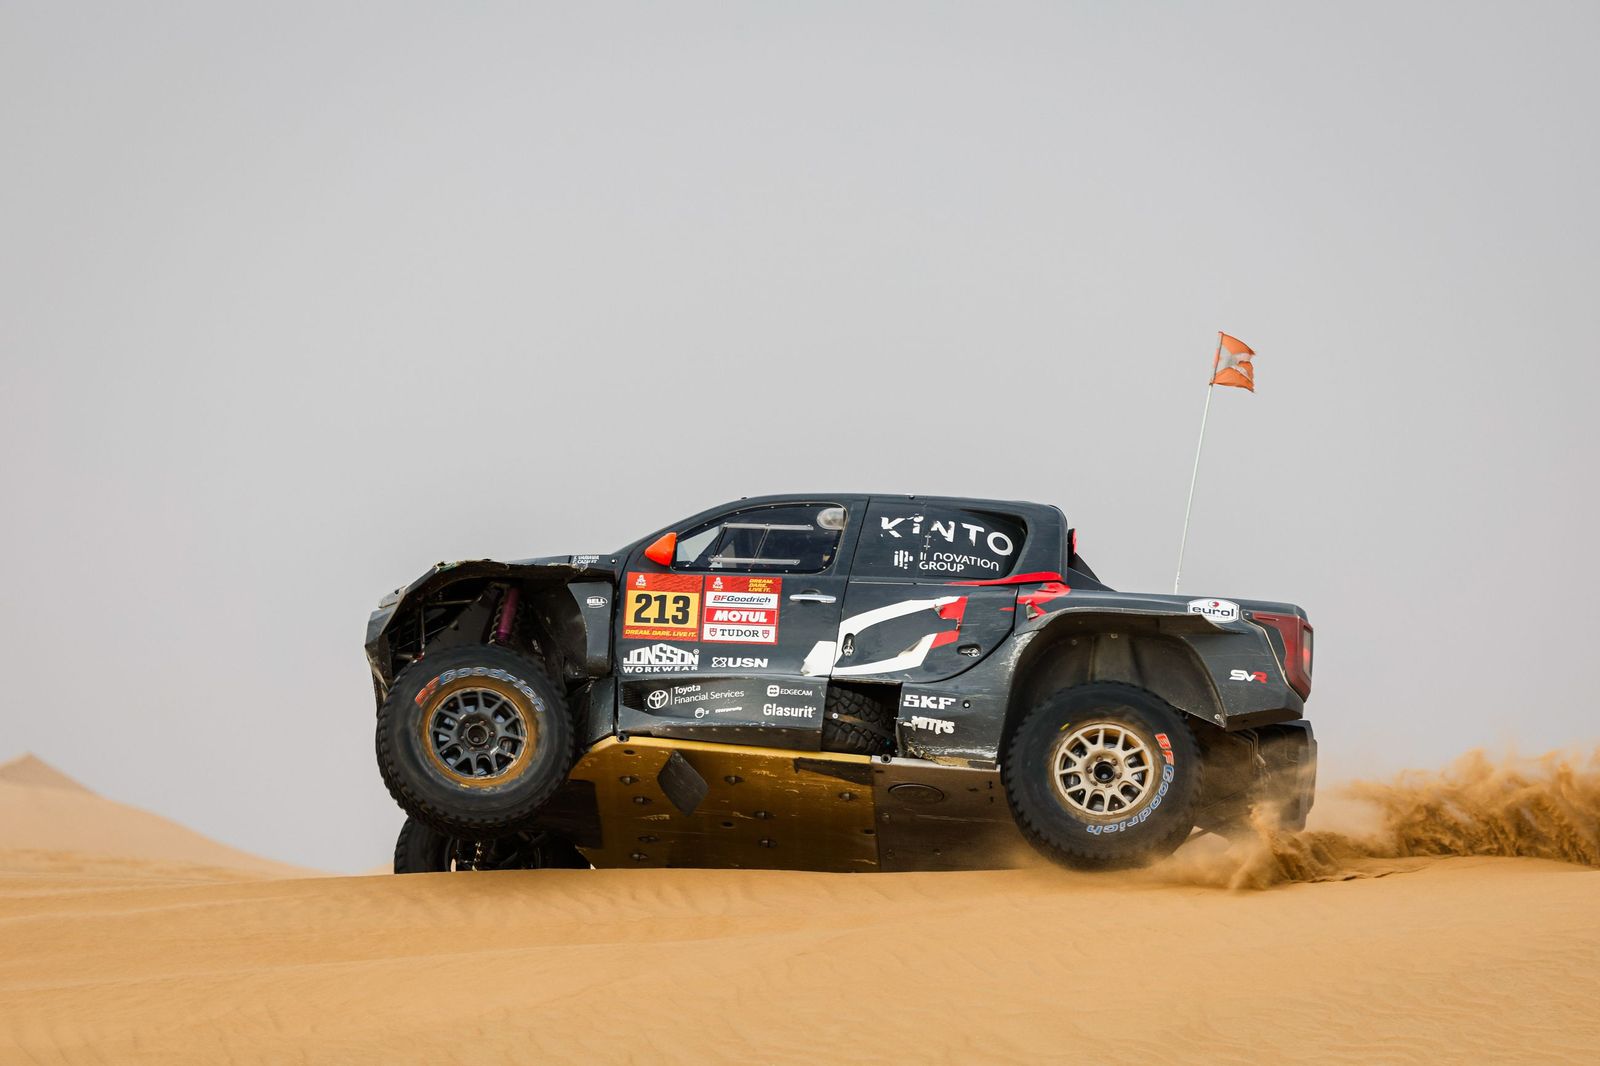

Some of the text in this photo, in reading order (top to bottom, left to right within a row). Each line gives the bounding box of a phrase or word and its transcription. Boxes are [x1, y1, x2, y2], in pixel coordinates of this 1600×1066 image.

[919, 561, 964, 572] GROUP
[713, 595, 771, 603] BFGoodrich
[634, 593, 691, 625] 213
[1192, 606, 1234, 617] eurol
[713, 610, 768, 623] MOTUL
[720, 629, 759, 637] TUDOR
[623, 643, 699, 665] JONSSON
[727, 657, 769, 668] USN
[1229, 669, 1268, 684] SVR
[674, 685, 701, 695] Toyota
[780, 688, 813, 696] EDGECAM
[674, 690, 745, 705] Financial Services
[903, 694, 956, 710] SKF
[763, 703, 813, 718] Glasurit
